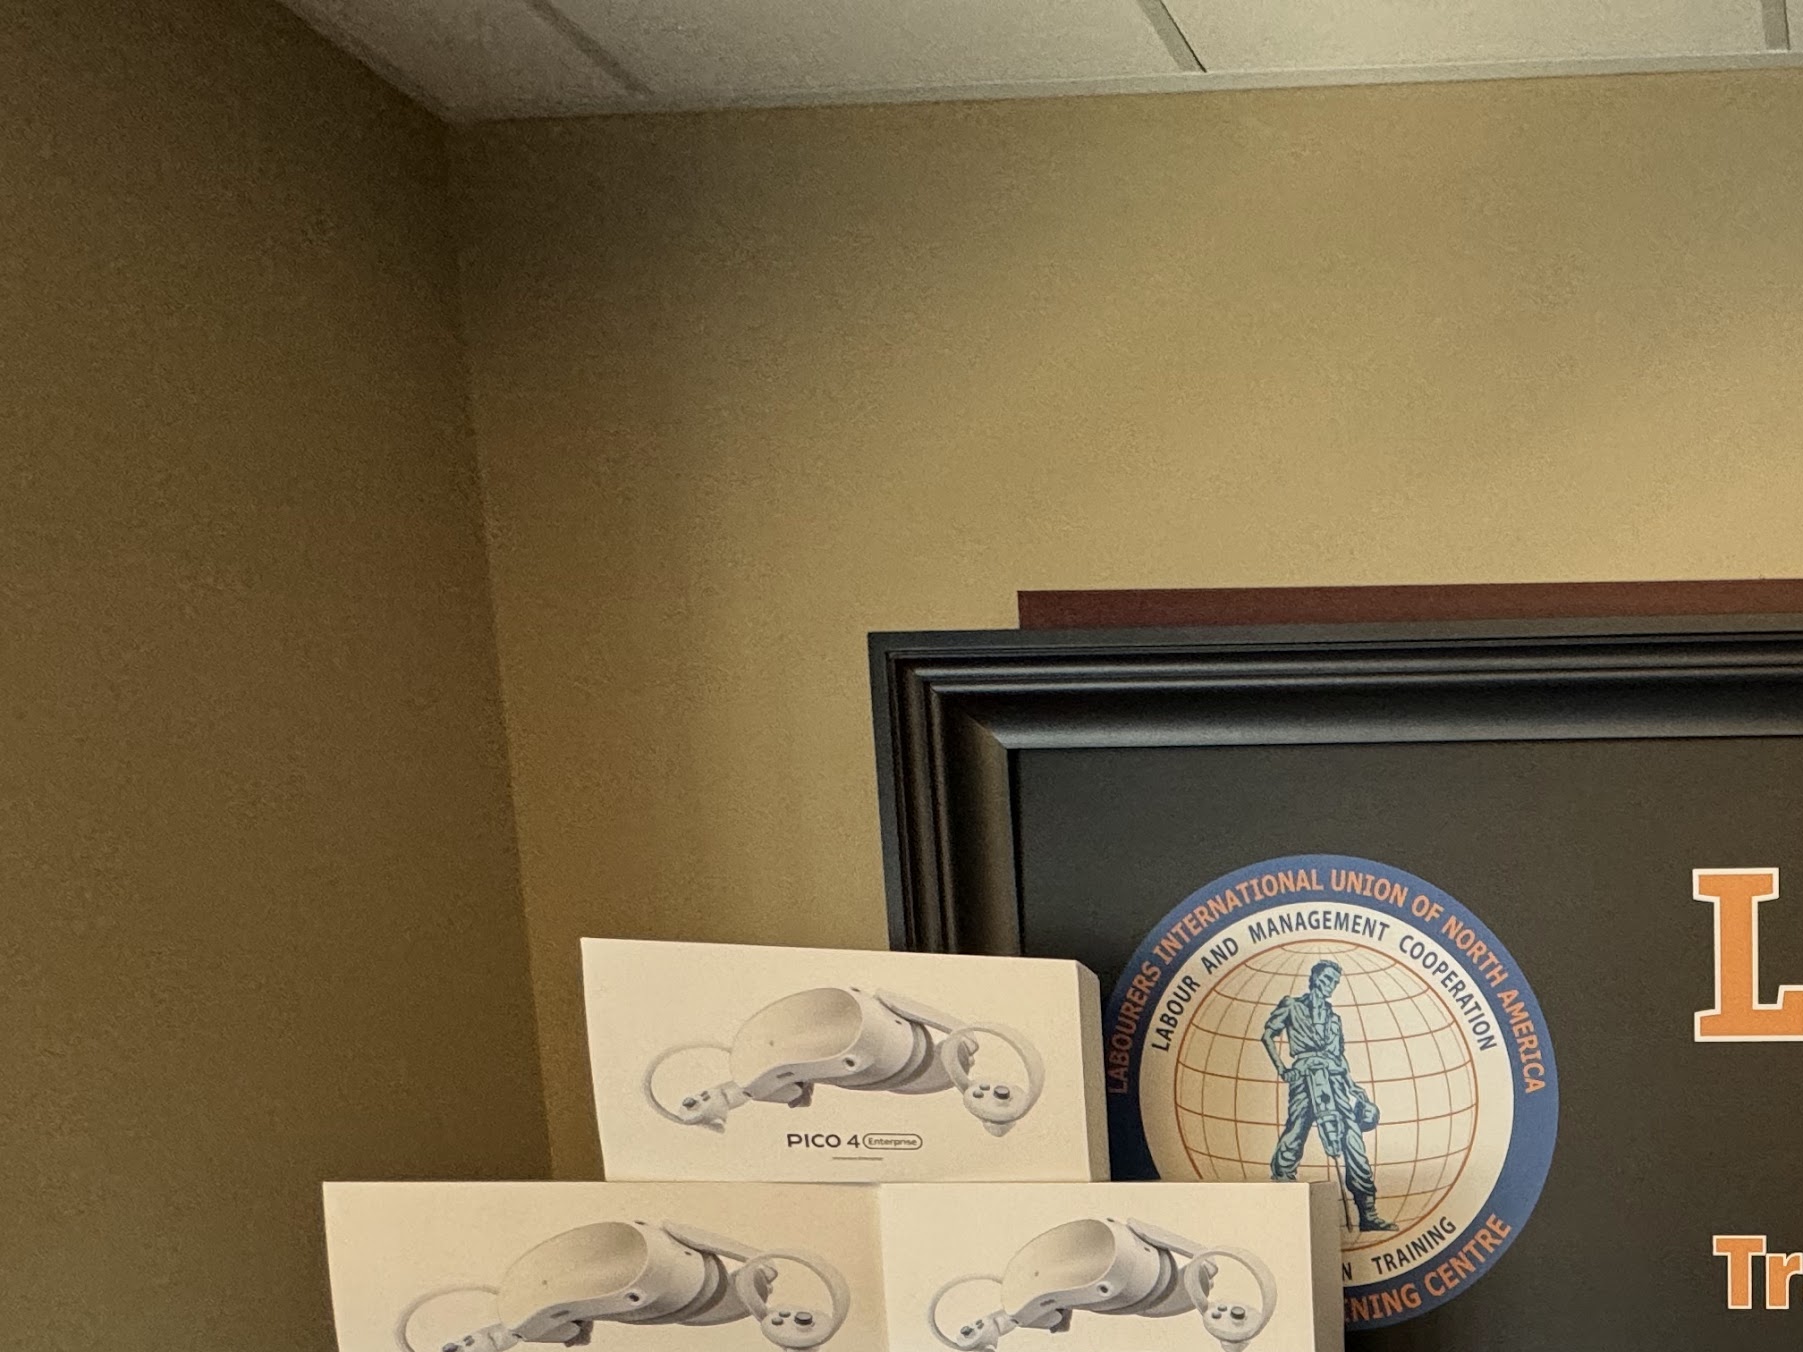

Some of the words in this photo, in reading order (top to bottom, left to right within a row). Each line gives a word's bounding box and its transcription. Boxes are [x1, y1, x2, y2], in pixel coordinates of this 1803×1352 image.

[1107, 961, 1161, 1094] LABOURERS
[1153, 869, 1325, 963] INTERNATIONAL
[1331, 869, 1408, 909] UNION
[1411, 896, 1445, 923] OF
[1443, 916, 1508, 988] NORTH
[1499, 988, 1546, 1094] AMERICA
[1151, 974, 1200, 1052] LABOUR
[1201, 937, 1240, 974] AND
[1248, 910, 1391, 943] MANAGEMENT
[1399, 934, 1498, 1053] COOPERATION
[786, 1133, 841, 1148] PICO
[846, 1134, 861, 1148] 4
[868, 1137, 918, 1147] Enterprise
[1371, 1216, 1457, 1275] TRAINING
[1424, 1213, 1512, 1297] CENTRE
